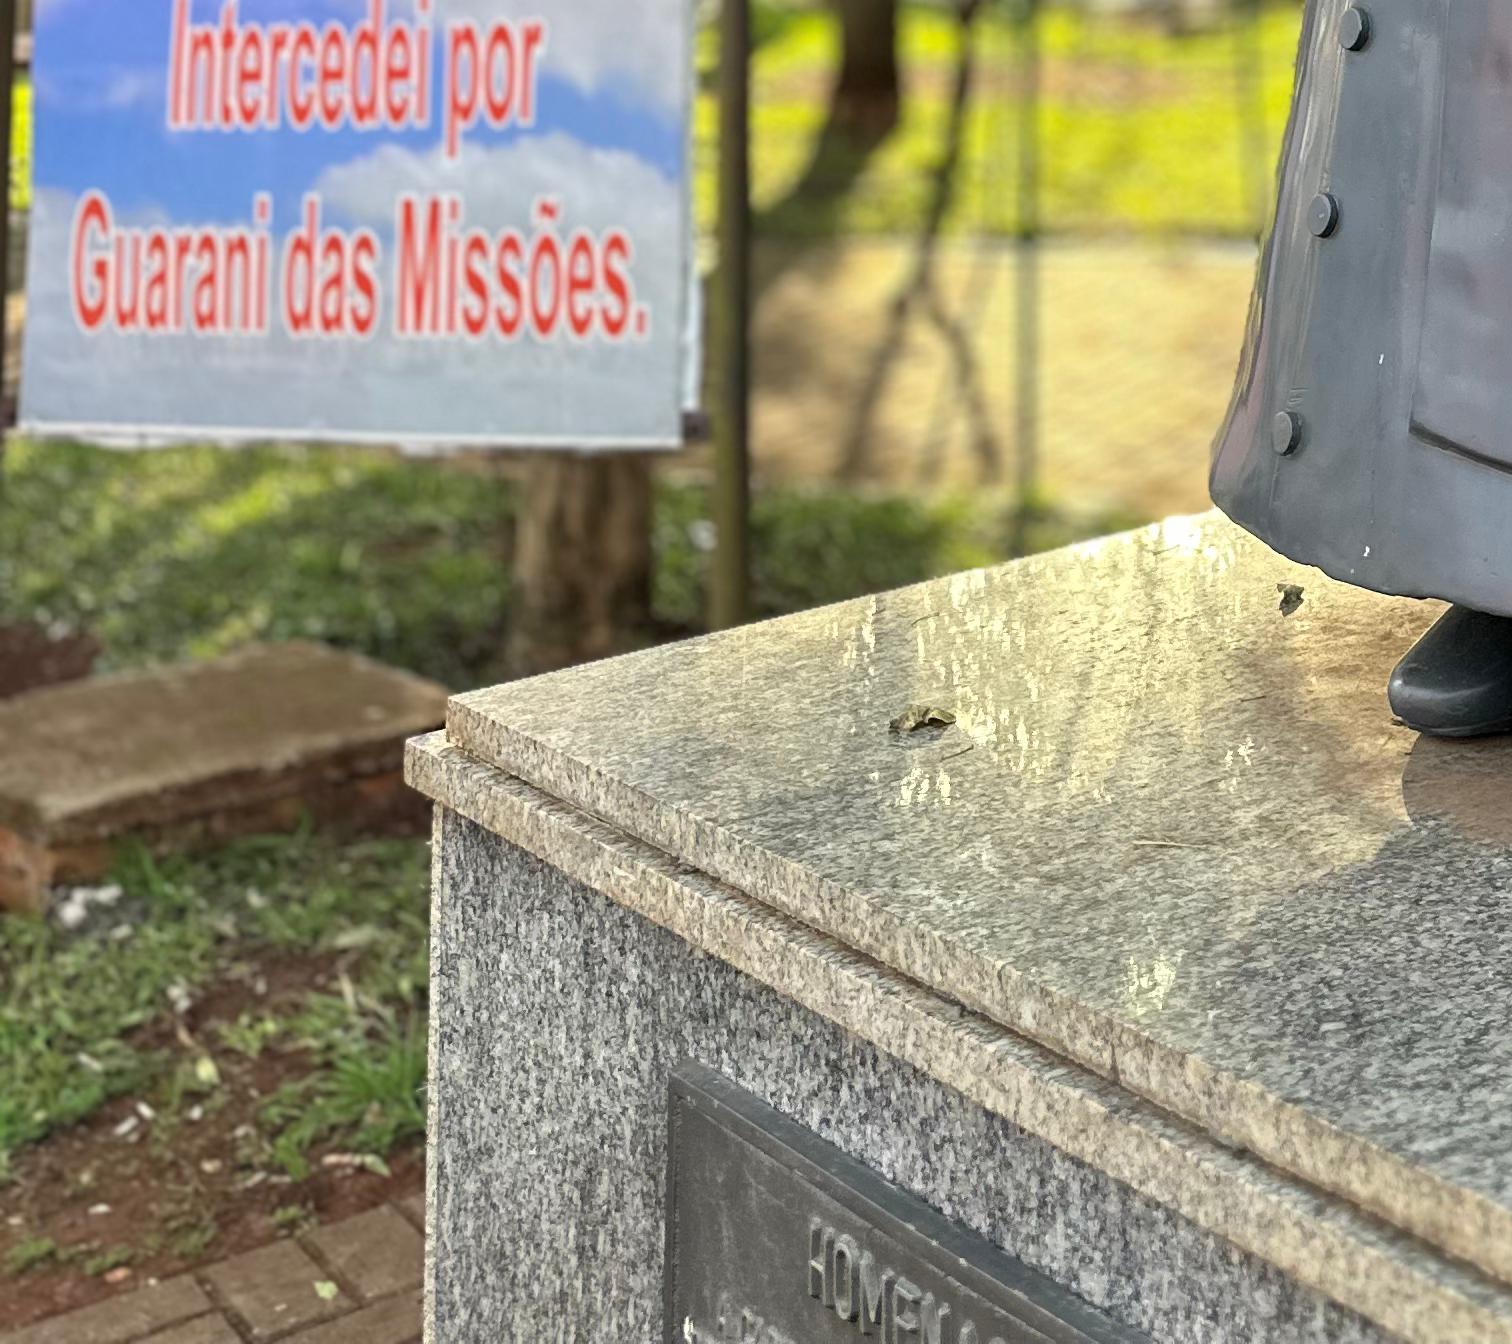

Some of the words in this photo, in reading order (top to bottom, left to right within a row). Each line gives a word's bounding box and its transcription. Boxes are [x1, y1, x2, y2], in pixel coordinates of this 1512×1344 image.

[444, 20, 544, 158] por
[73, 194, 270, 332] Guarani
[285, 196, 378, 335] das
[397, 196, 650, 337] Missões.
